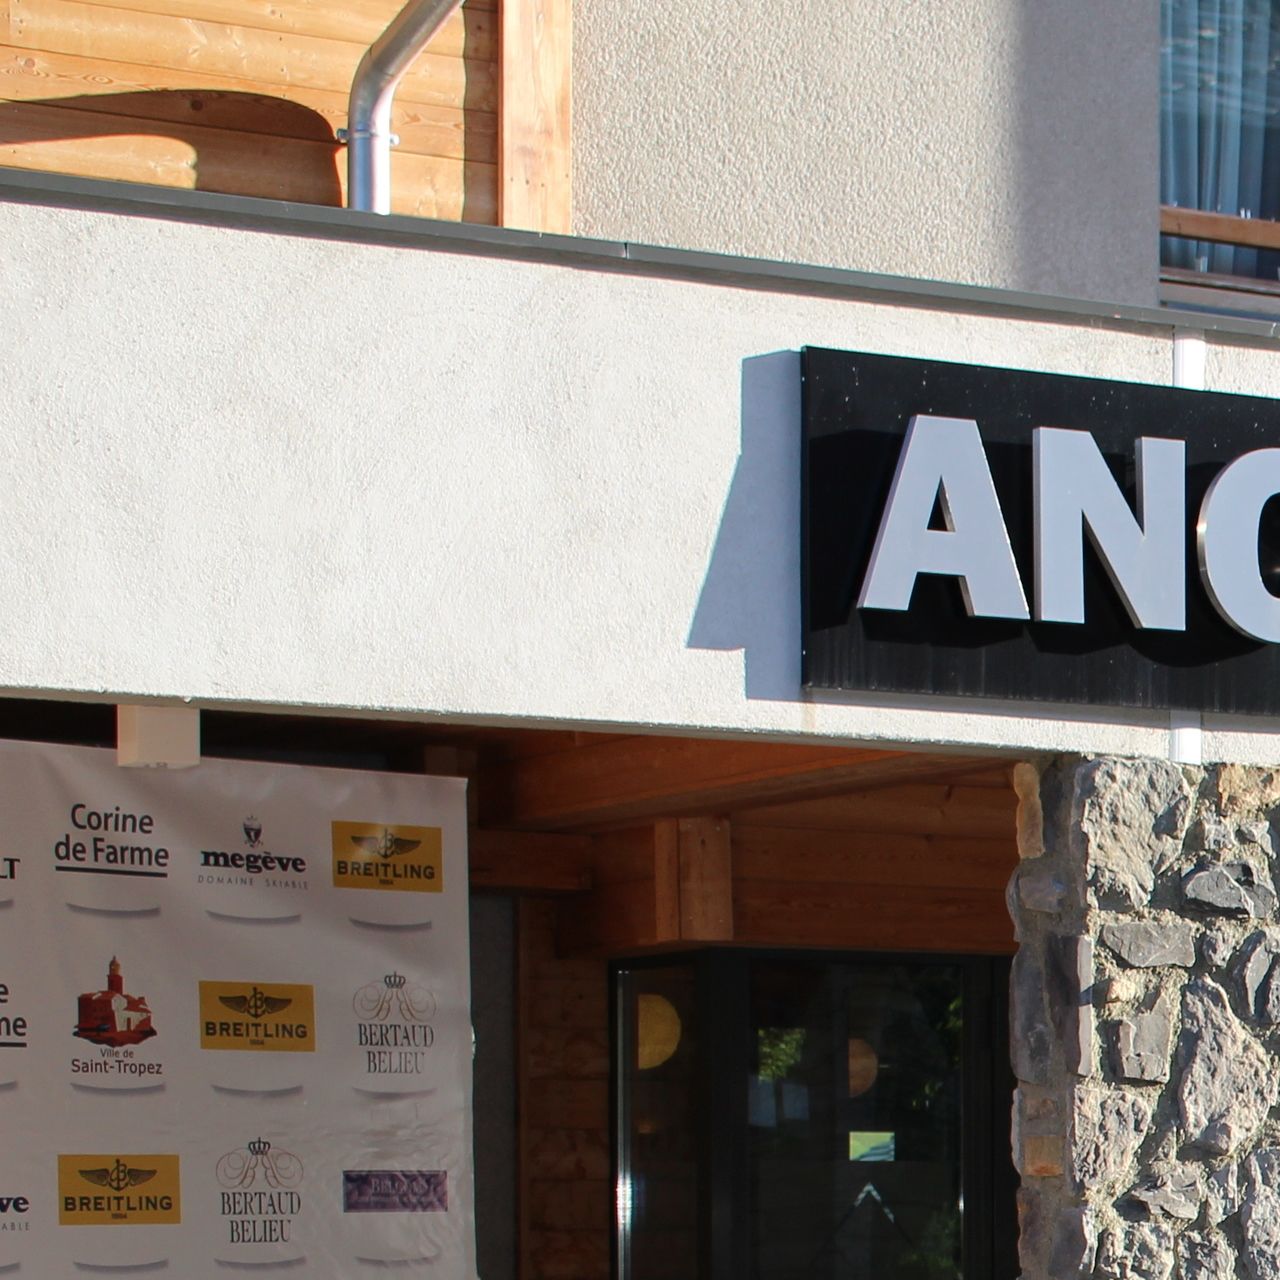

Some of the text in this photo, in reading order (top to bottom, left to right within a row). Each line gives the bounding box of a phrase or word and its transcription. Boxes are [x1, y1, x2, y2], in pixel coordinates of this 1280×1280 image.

[71, 803, 154, 834] Corine
[54, 833, 170, 867] de Farme
[200, 849, 306, 873] megève
[197, 874, 309, 890] DOMAINE SKIABLE
[337, 860, 435, 880] BREITLING
[205, 1022, 308, 1039] BREITLING
[358, 1024, 434, 1048] BERTAUD
[100, 1048, 134, 1059] Ville de
[367, 1050, 425, 1074] BELIEU
[71, 1058, 163, 1077] Saint-Tropez
[64, 1195, 173, 1212] BREITLING
[220, 1192, 301, 1216] BERTAUD
[229, 1219, 292, 1243] BELIEU
